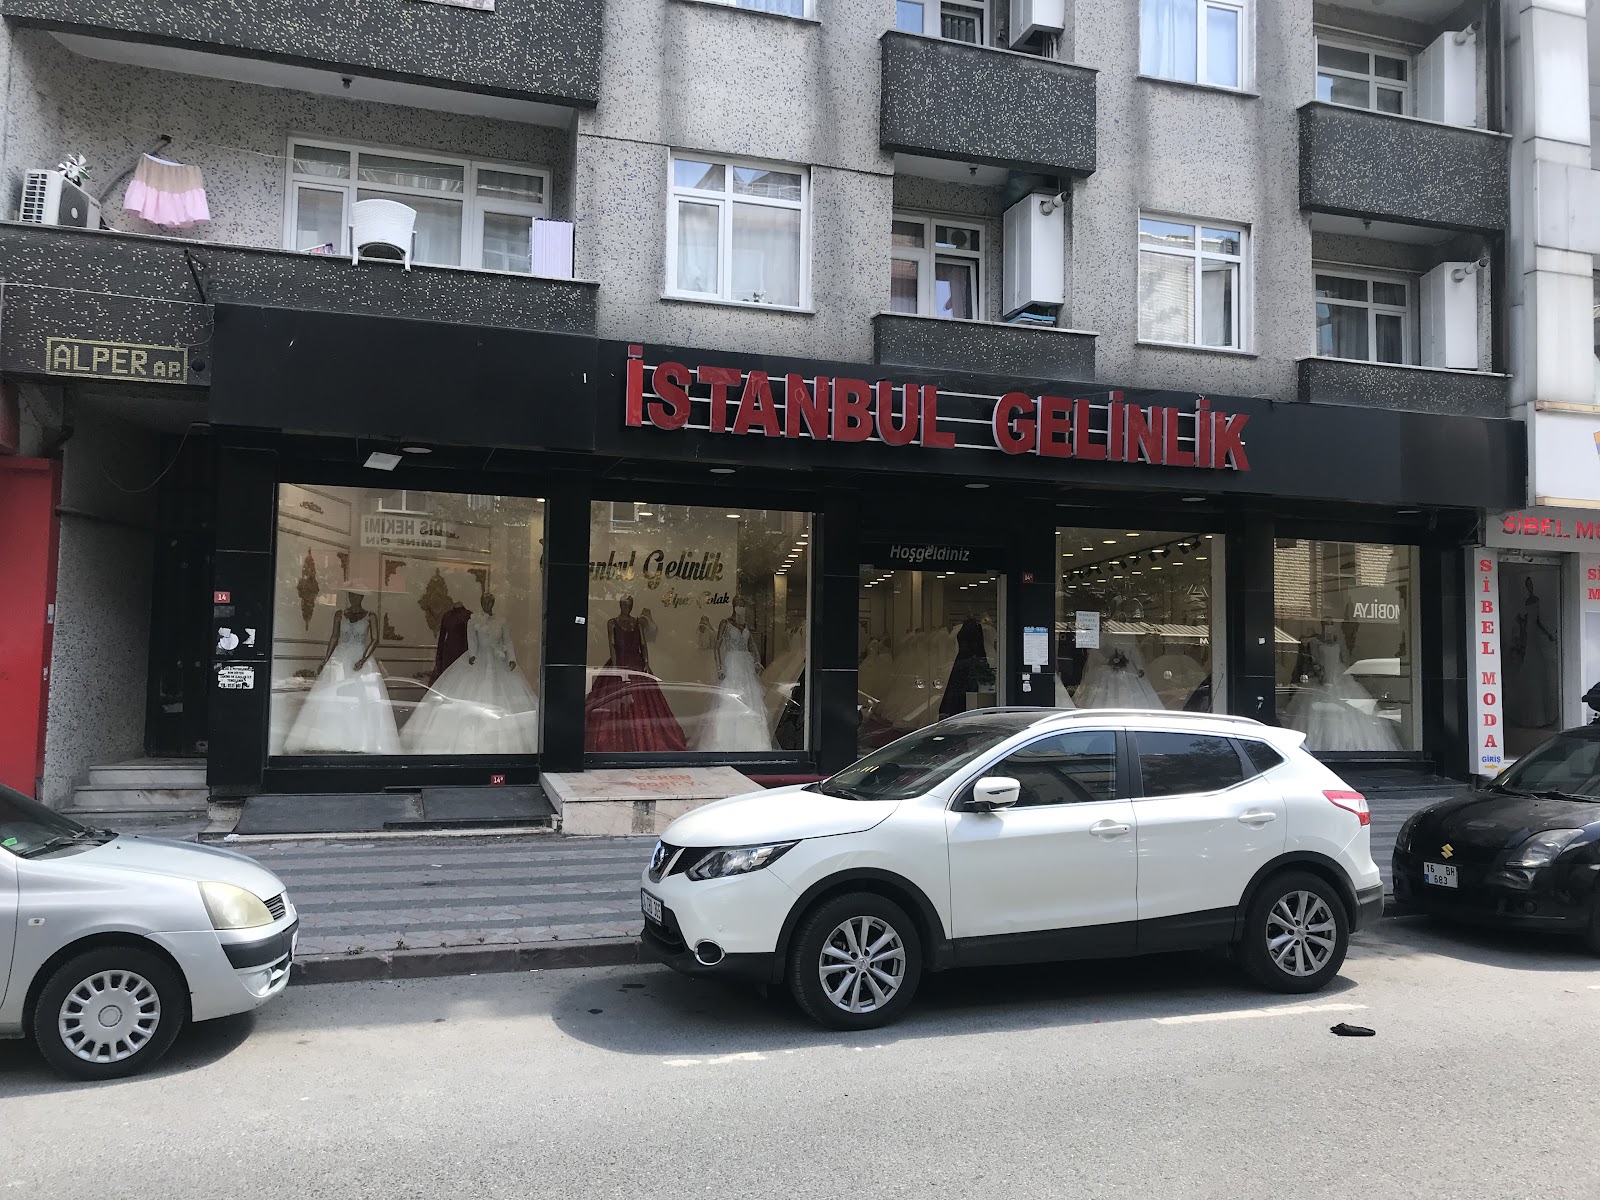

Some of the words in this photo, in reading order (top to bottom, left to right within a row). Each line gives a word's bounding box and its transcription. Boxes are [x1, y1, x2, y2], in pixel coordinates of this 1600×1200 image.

[53, 344, 148, 376] ALPER
[153, 360, 181, 378] AP.
[625, 344, 956, 449] İSTANBUL
[992, 390, 1251, 471] GELİNLİK
[1502, 511, 1570, 538] SİBEL
[890, 544, 970, 563] Hoşgeldiniz
[642, 549, 724, 590] Gelinlik
[217, 593, 227, 601] 14
[1479, 559, 1495, 655] SİBEL
[1481, 671, 1498, 748] MODA
[1481, 754, 1501, 763] GİRİŞ
[1426, 864, 1435, 873] 16
